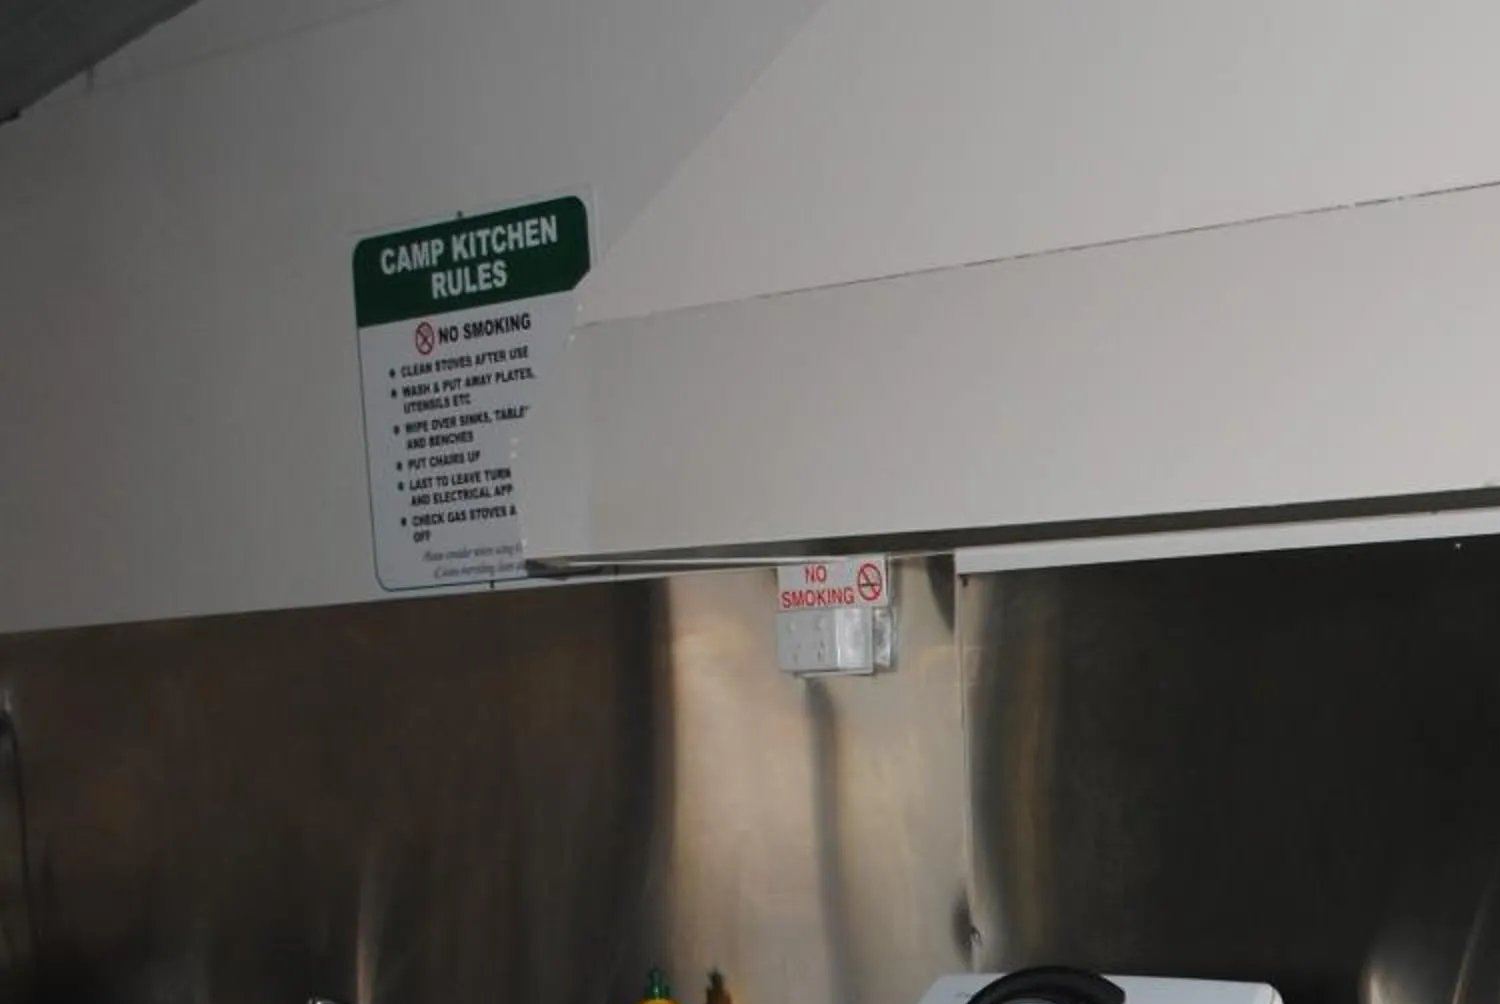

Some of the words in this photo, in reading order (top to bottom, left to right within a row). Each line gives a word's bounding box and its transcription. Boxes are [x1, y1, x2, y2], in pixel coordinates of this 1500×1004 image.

[380, 240, 444, 275] CAMP
[452, 215, 558, 261] KITCHEN
[432, 260, 509, 299] RULES
[438, 326, 459, 344] NO
[463, 313, 531, 339] SMOKING
[401, 363, 432, 378] CLEAN
[435, 356, 472, 372] STOVES
[475, 350, 506, 365] AFTER
[509, 345, 529, 360] USE
[402, 383, 430, 398] WASH
[442, 378, 462, 392] PUT
[465, 373, 493, 387] AWAY
[404, 397, 450, 414] UTENSILS
[453, 393, 471, 407] ETC
[405, 420, 428, 433] WIPE
[432, 416, 456, 431] OVER
[494, 405, 529, 420] TABLE
[407, 437, 426, 450] AND
[429, 431, 474, 447] BENCHES
[408, 457, 426, 471] PUT
[429, 452, 465, 468] CHAIRS
[468, 450, 481, 463] UP
[409, 477, 433, 491] LAST
[436, 475, 449, 487] TO
[451, 471, 481, 486] LEAVE
[484, 468, 512, 481] TURN
[411, 495, 430, 506] AND
[433, 487, 491, 505] ELECTRICAL
[412, 512, 445, 527] CHECK
[448, 509, 466, 523] GAS
[469, 506, 507, 521] STOVES
[413, 530, 431, 543] OFF
[804, 565, 826, 583] NO
[781, 587, 855, 609] SMOKING
